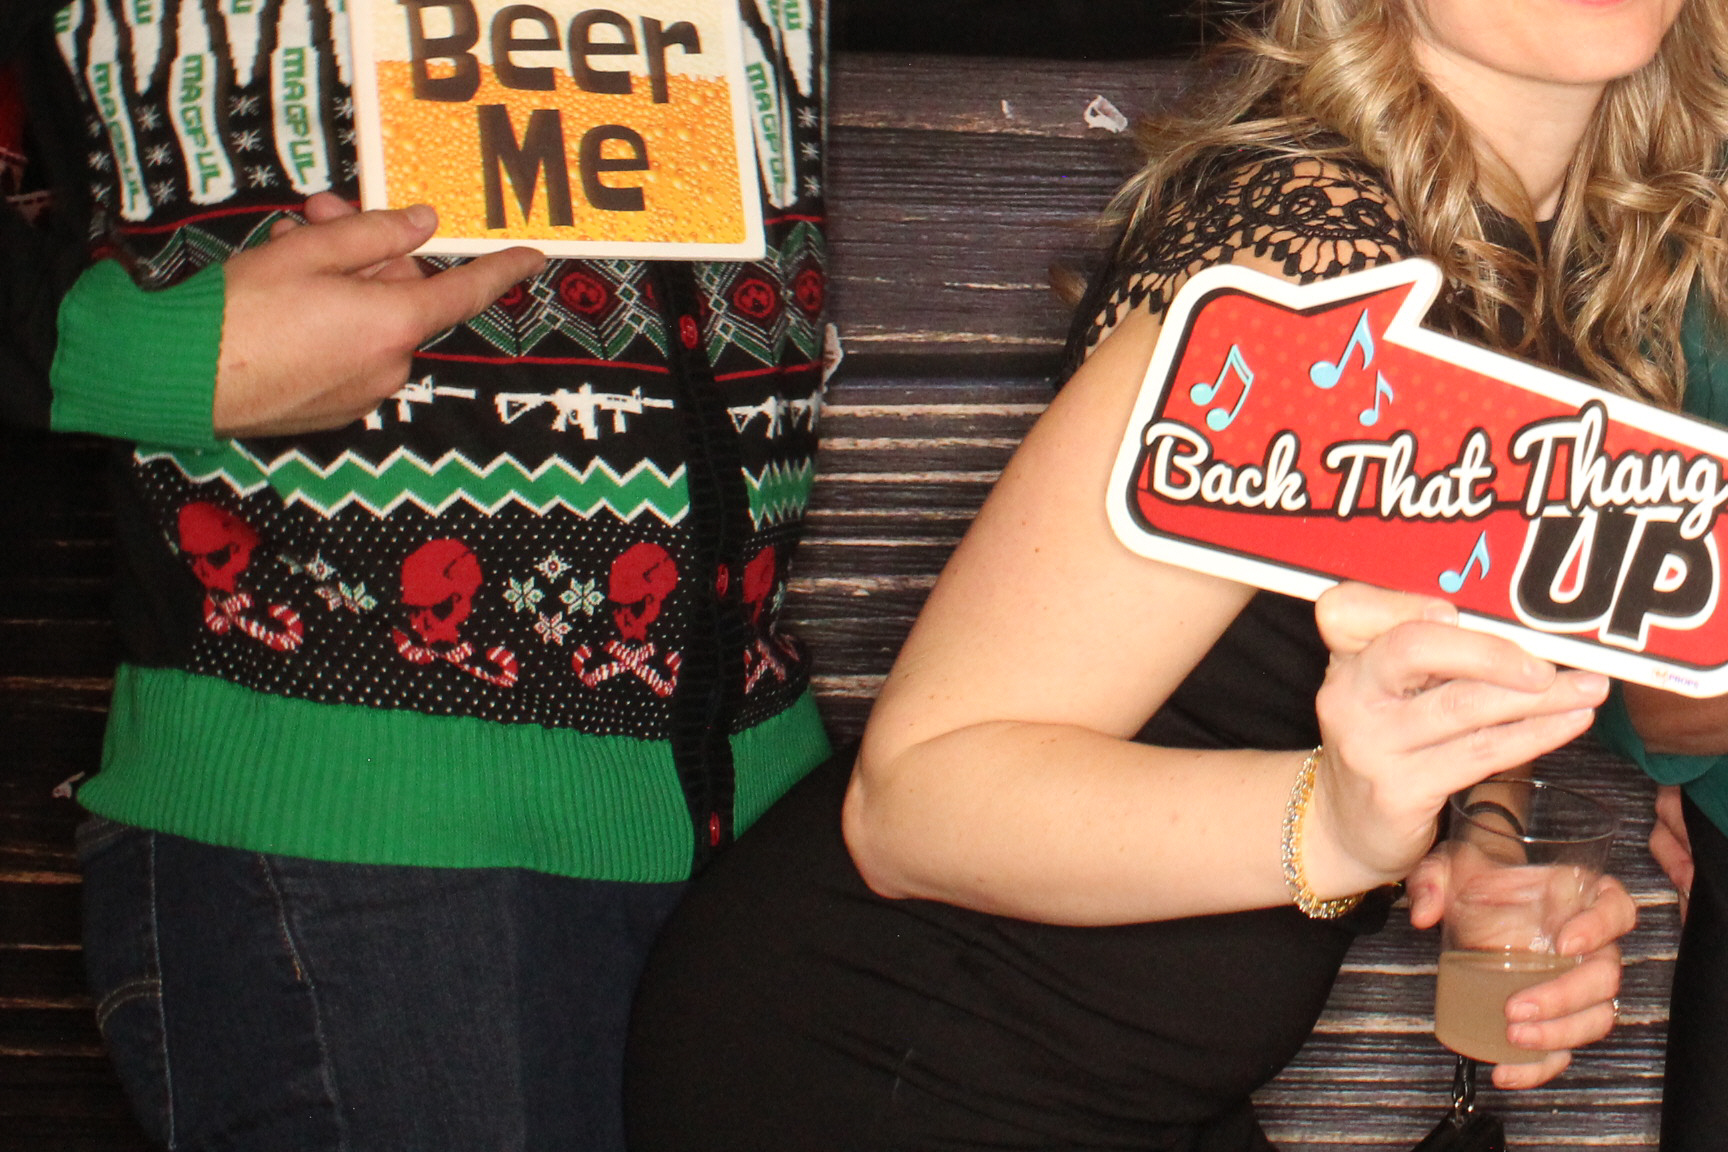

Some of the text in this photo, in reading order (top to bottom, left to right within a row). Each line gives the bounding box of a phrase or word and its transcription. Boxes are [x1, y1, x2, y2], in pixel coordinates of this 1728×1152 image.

[181, 54, 220, 195] MAGPUL
[283, 47, 315, 186] MAGPUL
[477, 103, 649, 231] Me
[1146, 427, 1309, 511] Back
[1326, 433, 1493, 520] That
[1513, 506, 1721, 649] UP
